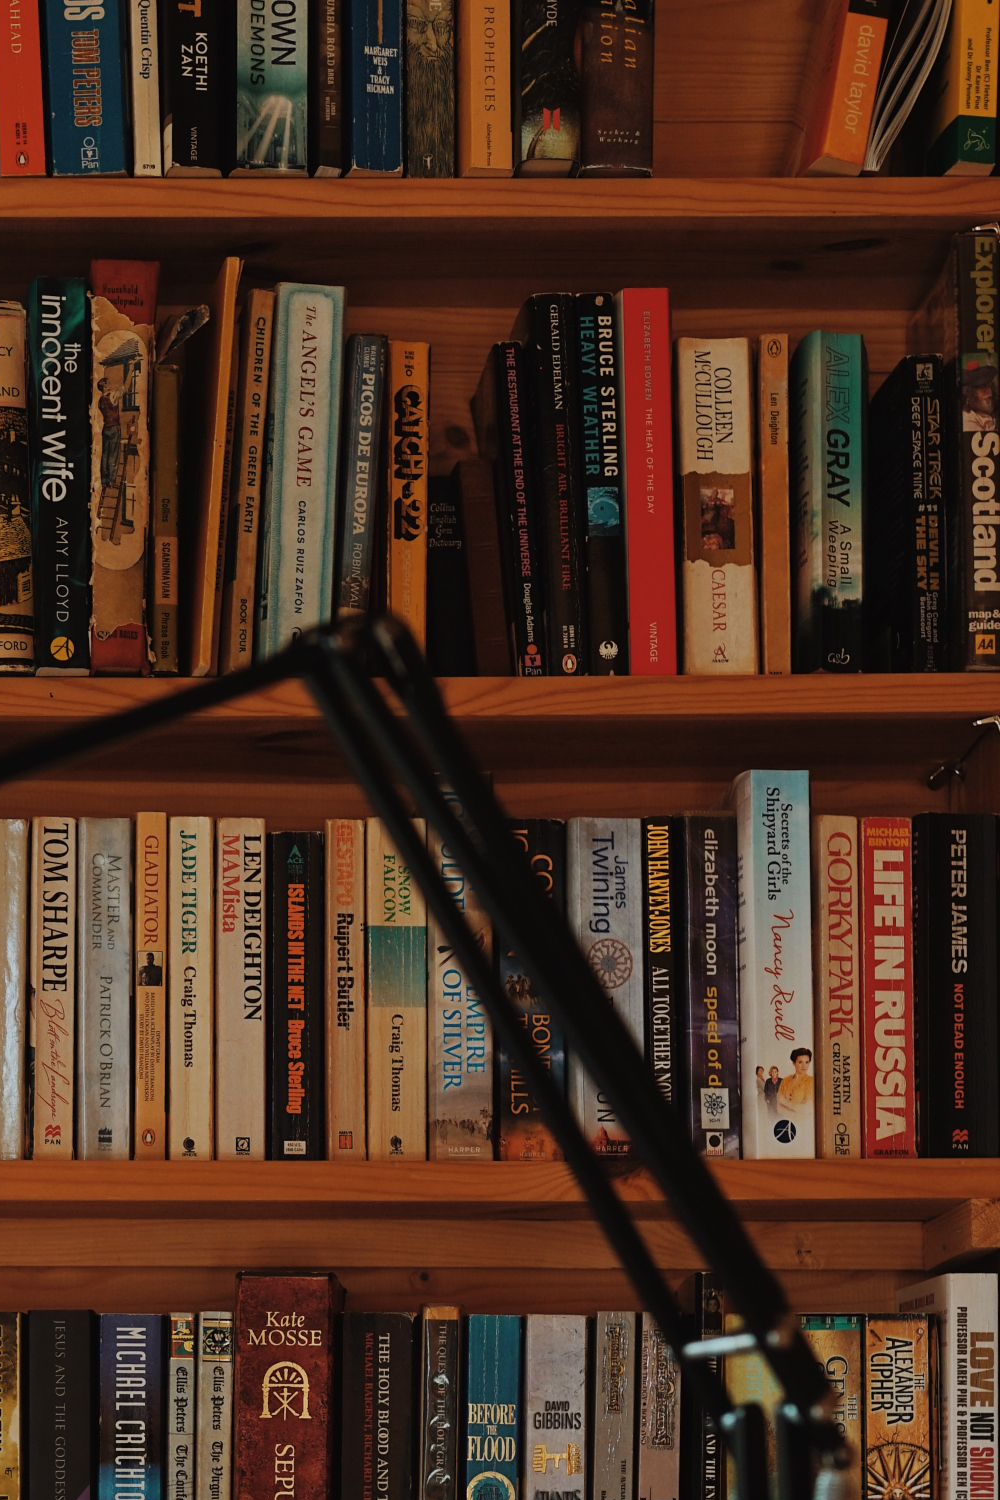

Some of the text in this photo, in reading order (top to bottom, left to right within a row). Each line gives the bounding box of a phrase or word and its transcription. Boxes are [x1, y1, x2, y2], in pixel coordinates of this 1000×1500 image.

[71, 29, 102, 127] TOM PETERS
[181, 44, 193, 78] ZAN
[195, 32, 208, 92] KOETHI
[364, 46, 398, 57] MARGARET
[366, 85, 395, 95] HICKMAN
[370, 74, 390, 84] TRACY
[373, 57, 388, 66] WEIS
[484, 7, 496, 112] PROPHECIES
[845, 24, 876, 134] david taylor
[82, 159, 100, 169] Pan
[971, 236, 997, 353] Explorer
[41, 294, 74, 503] innocent wife
[64, 342, 82, 374] the
[296, 305, 318, 487] The ANGEL'S GAME
[580, 316, 599, 476] HEAVY WEATHER
[597, 316, 618, 477] BRUCE STERLING
[714, 368, 733, 444] COLLEEN
[827, 429, 850, 506] GRAY
[971, 432, 1000, 591] Scotland
[55, 516, 69, 623] AMY LLOYD
[711, 570, 727, 631] CAESAR
[649, 622, 658, 662] VINTAGE
[42, 823, 70, 992] TOM SHARPE
[143, 835, 160, 946] GLADIATOR
[243, 834, 262, 1021] LEN DEIGHTON
[828, 832, 855, 1039] GORKY PARK
[180, 830, 197, 1068] JADE TIGER Craig Thomas
[874, 850, 906, 1140] LIFE IN RUSSIA
[950, 829, 968, 1109] PETER JAMES NOT DEAD ENOUGH
[100, 976, 112, 1108] PATRICK O'BRIAN
[247, 1330, 322, 1346] MOSSE
[266, 1312, 305, 1327] Kate
[54, 1321, 66, 1500] JESUS AND THE GODDESS
[545, 1401, 570, 1411] DAVID
[970, 1333, 995, 1408] LOVE
[534, 1412, 582, 1430] GIBBINS
[970, 1413, 995, 1442] NOT
